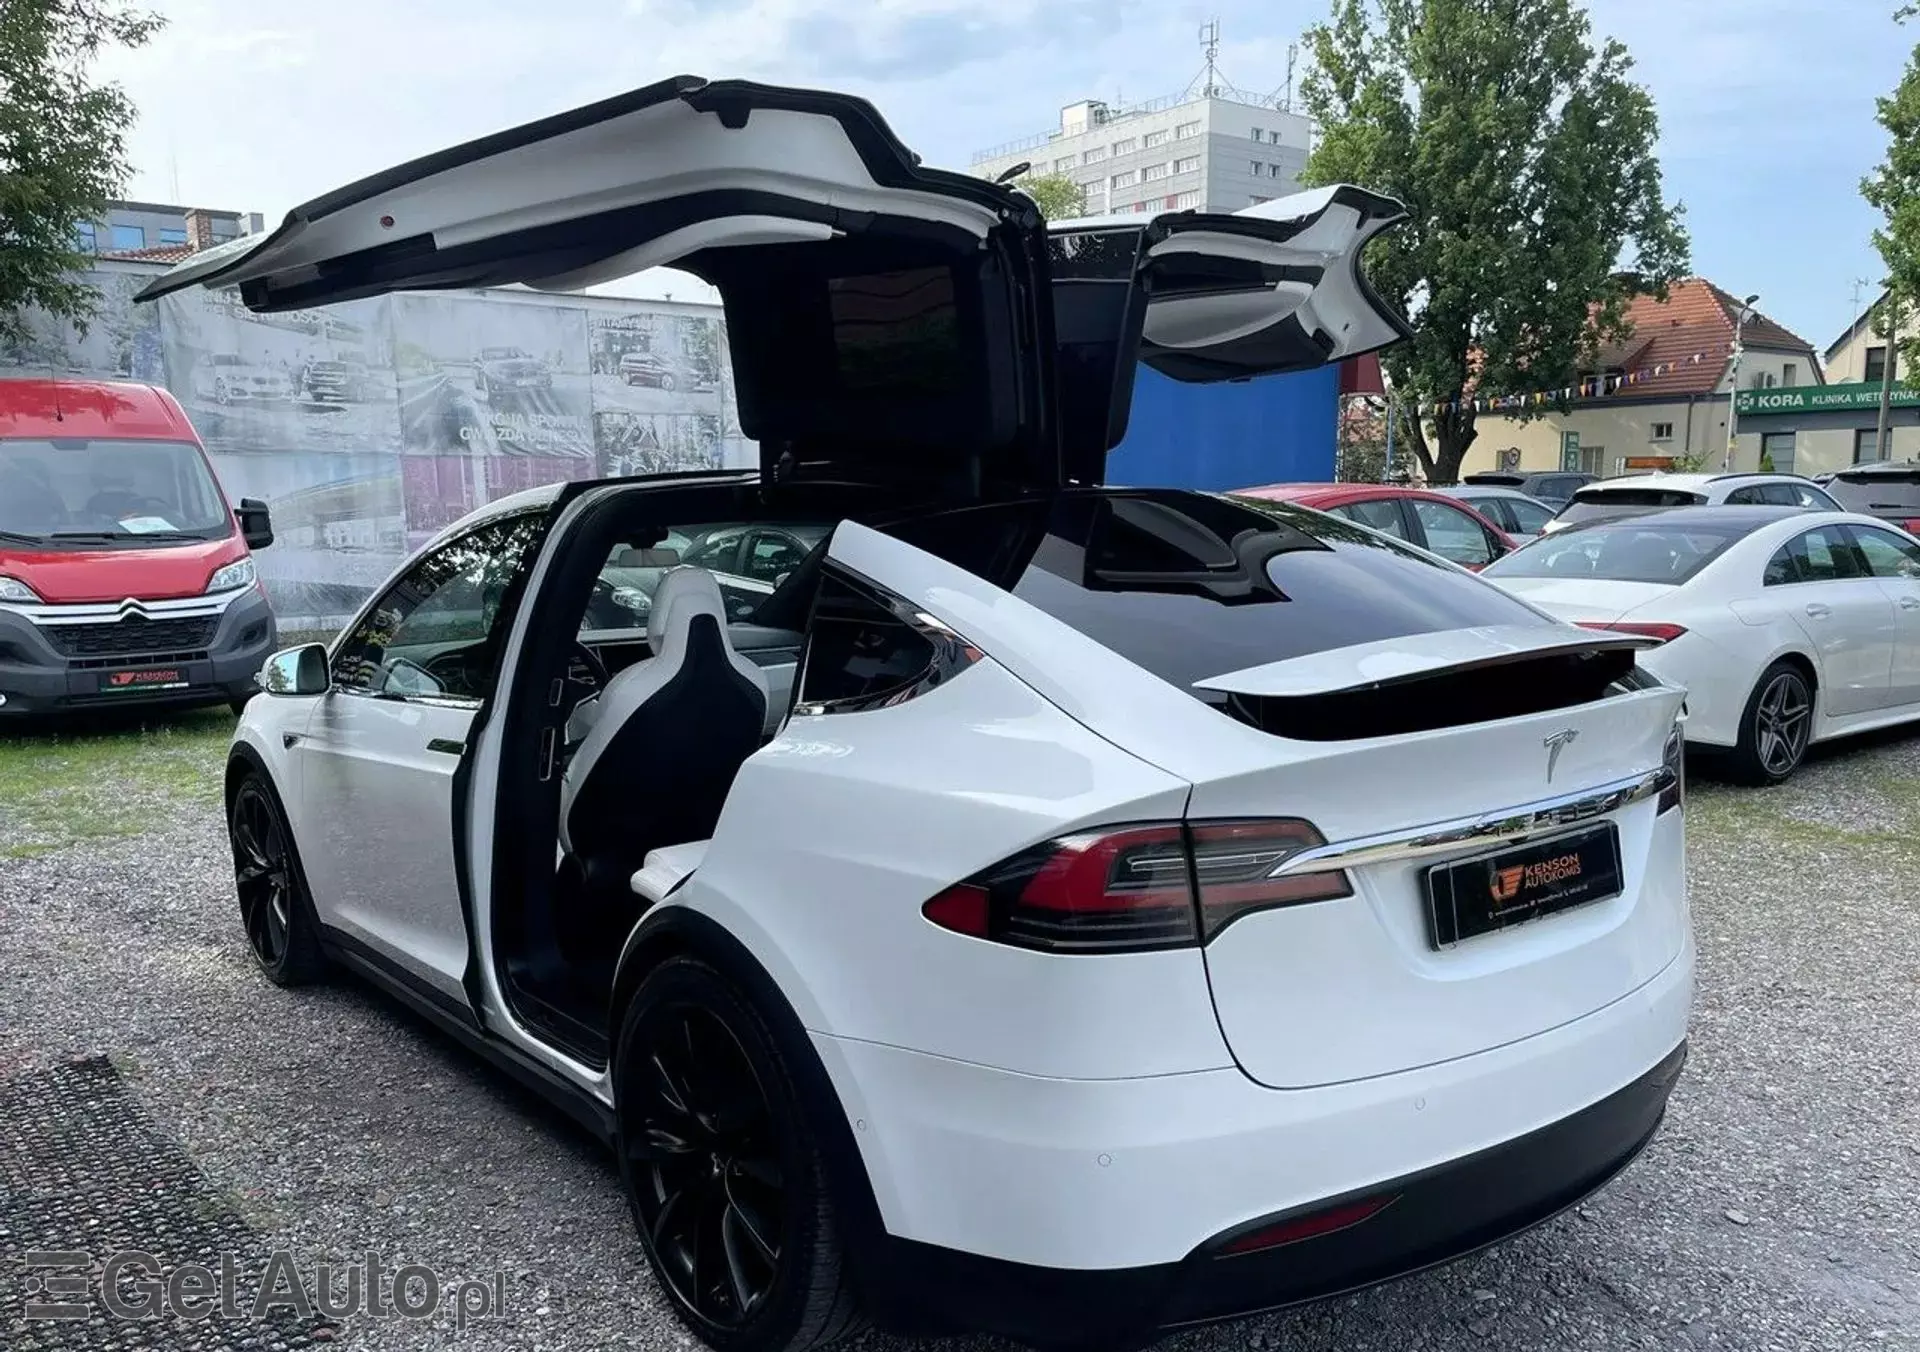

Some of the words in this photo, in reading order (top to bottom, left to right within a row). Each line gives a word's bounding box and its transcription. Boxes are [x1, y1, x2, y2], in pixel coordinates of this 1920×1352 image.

[1758, 394, 1804, 408] KORA
[1811, 394, 1851, 405] KLINIKA
[1525, 853, 1579, 877] KENSON
[1524, 866, 1581, 889] AUTOKOMIS
